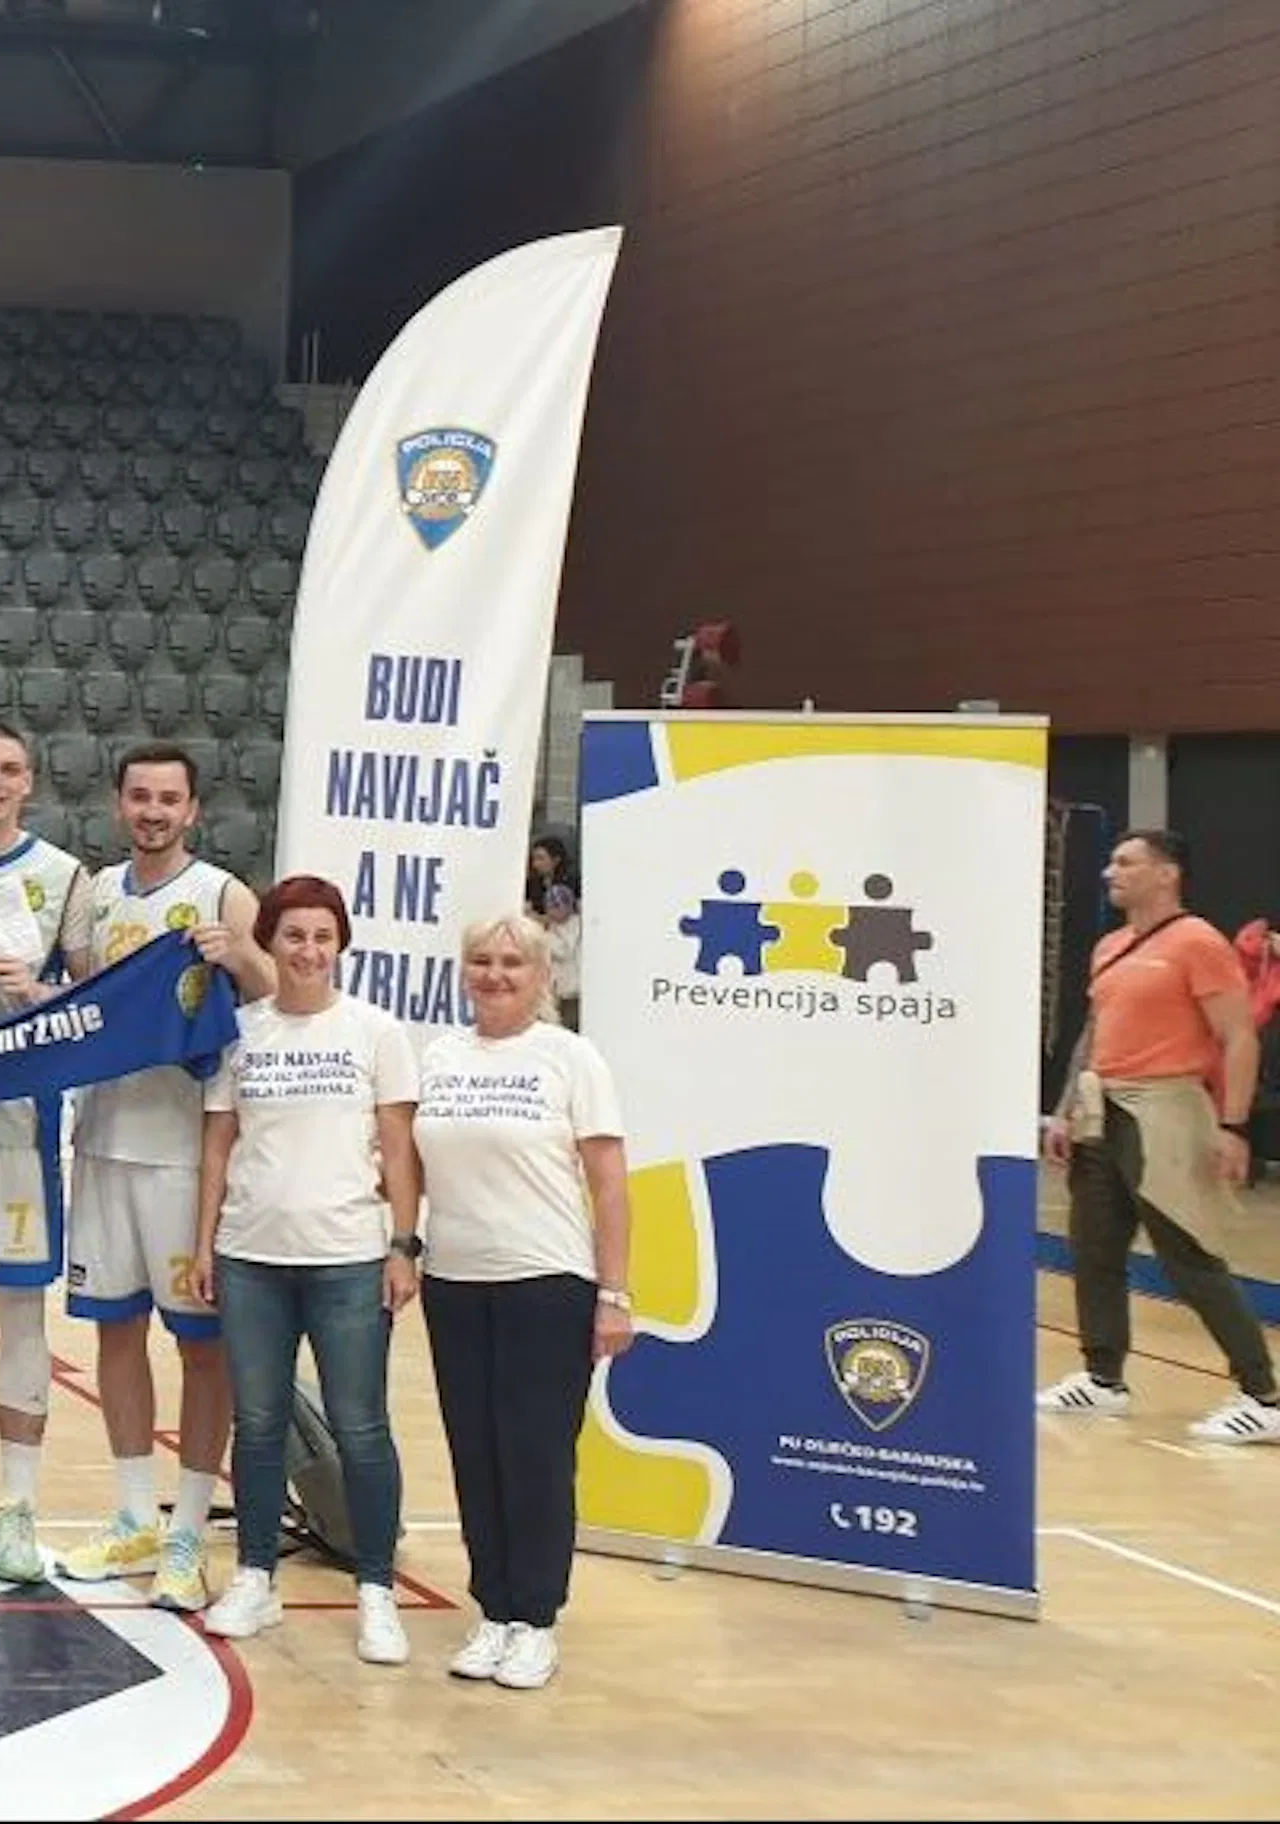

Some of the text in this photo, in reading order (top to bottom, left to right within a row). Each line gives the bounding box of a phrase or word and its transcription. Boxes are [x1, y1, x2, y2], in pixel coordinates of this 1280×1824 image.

[365, 653, 462, 726] BUDI
[325, 751, 502, 829] NAVIJAČ
[352, 851, 443, 924] A NE
[652, 978, 957, 1024] Prevencija spaja
[4, 1202, 30, 1242] 7
[779, 1435, 801, 1450] PU
[854, 1505, 918, 1538] 192
